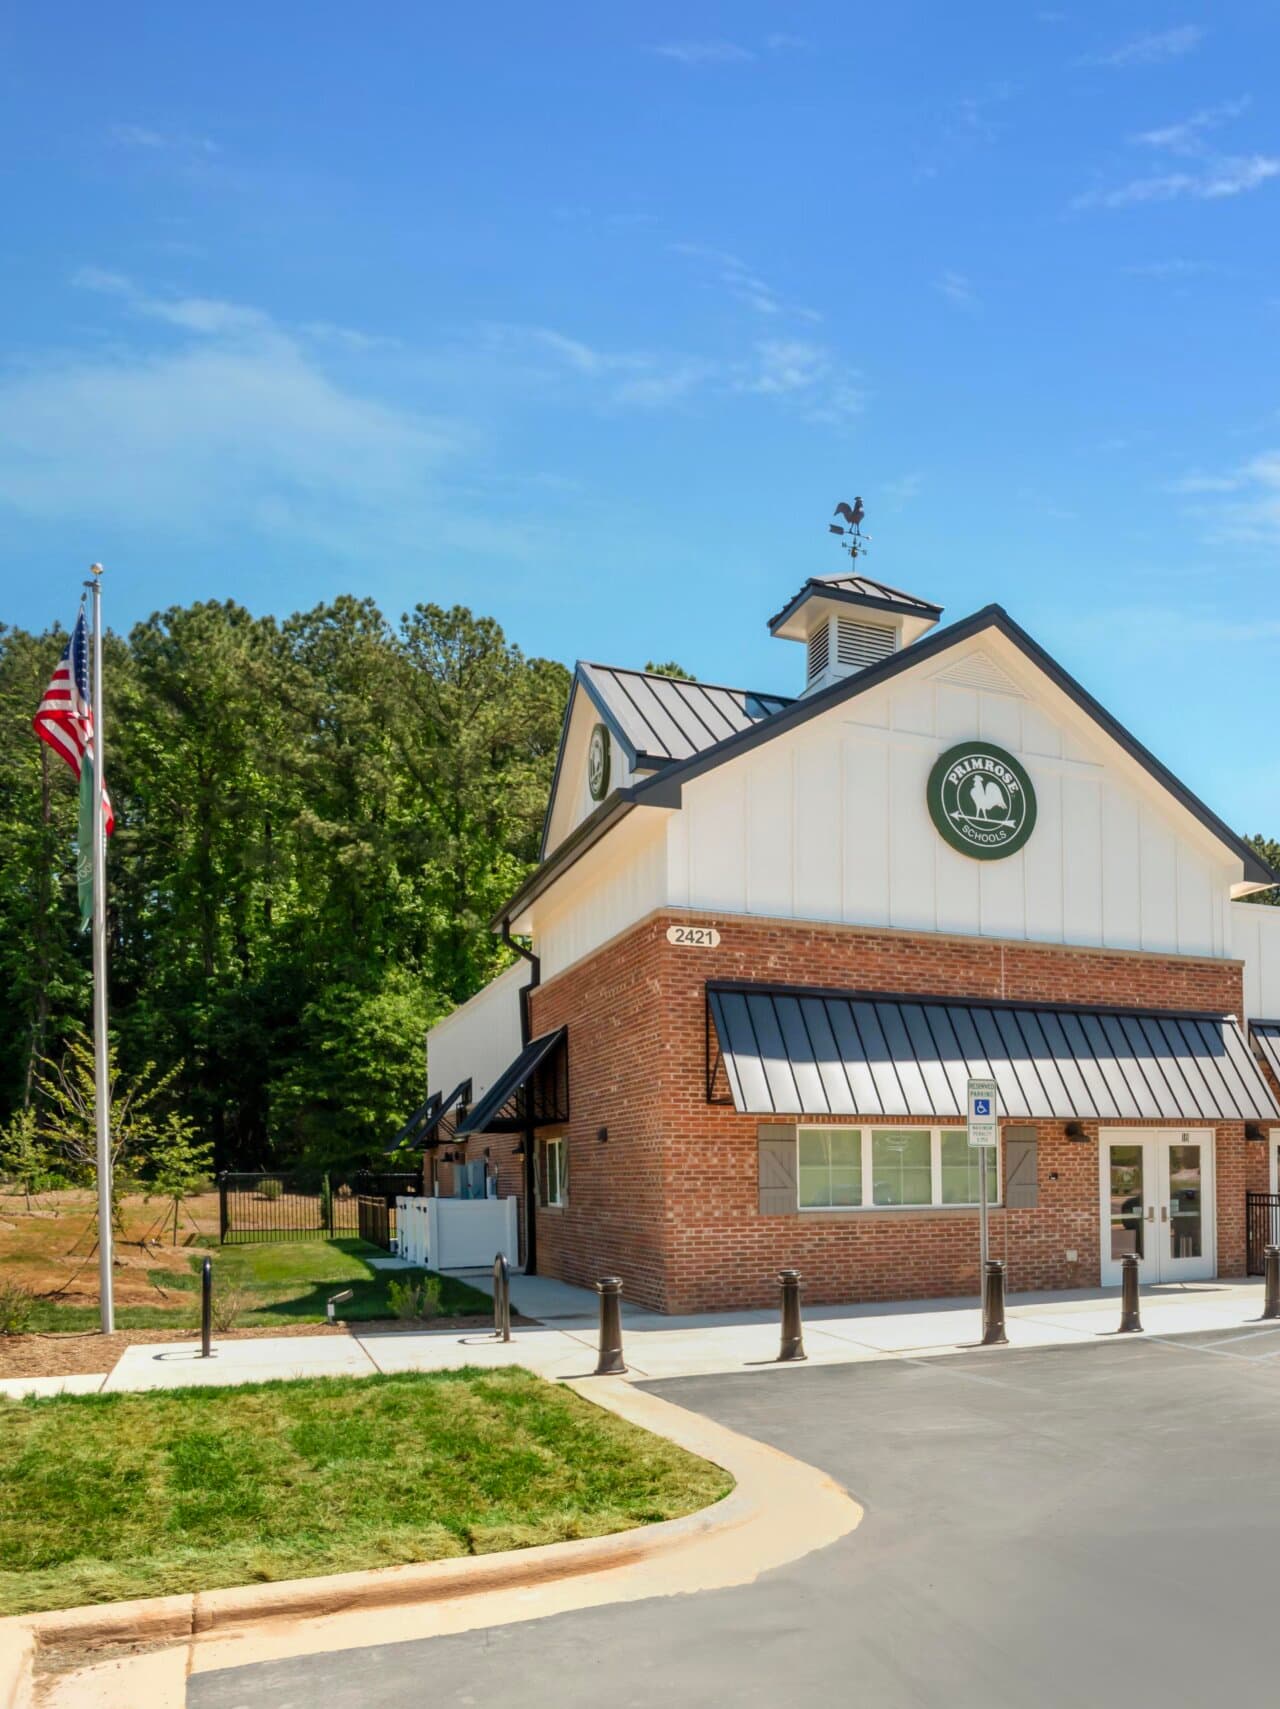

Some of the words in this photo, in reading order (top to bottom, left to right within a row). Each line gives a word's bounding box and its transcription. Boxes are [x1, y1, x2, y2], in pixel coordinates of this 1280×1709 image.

[948, 758, 1019, 794] PRIMROSE
[962, 824, 1006, 843] SCHOOLS
[675, 928, 713, 945] 2421
